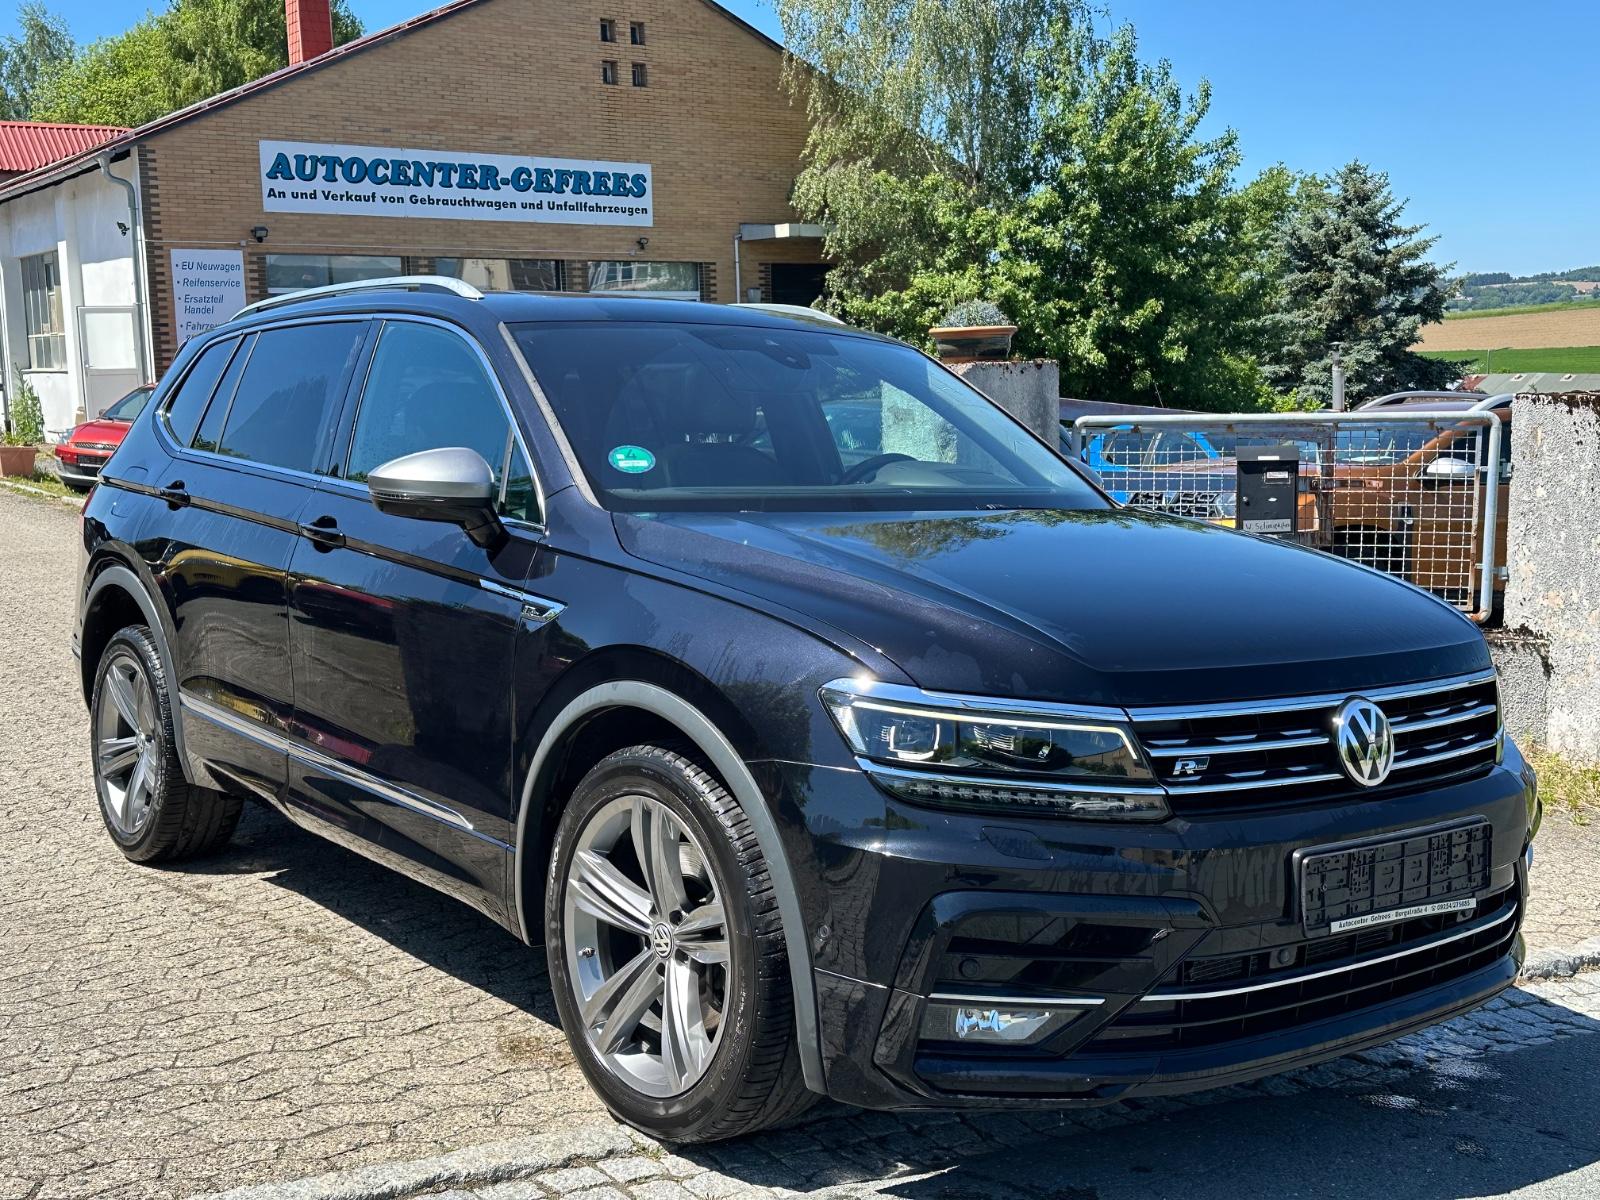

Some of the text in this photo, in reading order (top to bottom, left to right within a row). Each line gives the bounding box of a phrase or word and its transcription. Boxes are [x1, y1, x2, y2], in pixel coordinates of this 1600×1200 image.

[266, 152, 646, 198] AUTOCENTER-GEFREES
[267, 188, 648, 216] An und Verkauf von Gebrauchtwagen und Unfallfahrzeugen
[181, 261, 240, 273] EU Neuwagen
[182, 278, 241, 288] Reifenservice
[184, 294, 224, 304] Ersatzteil
[184, 305, 214, 315] Handel
